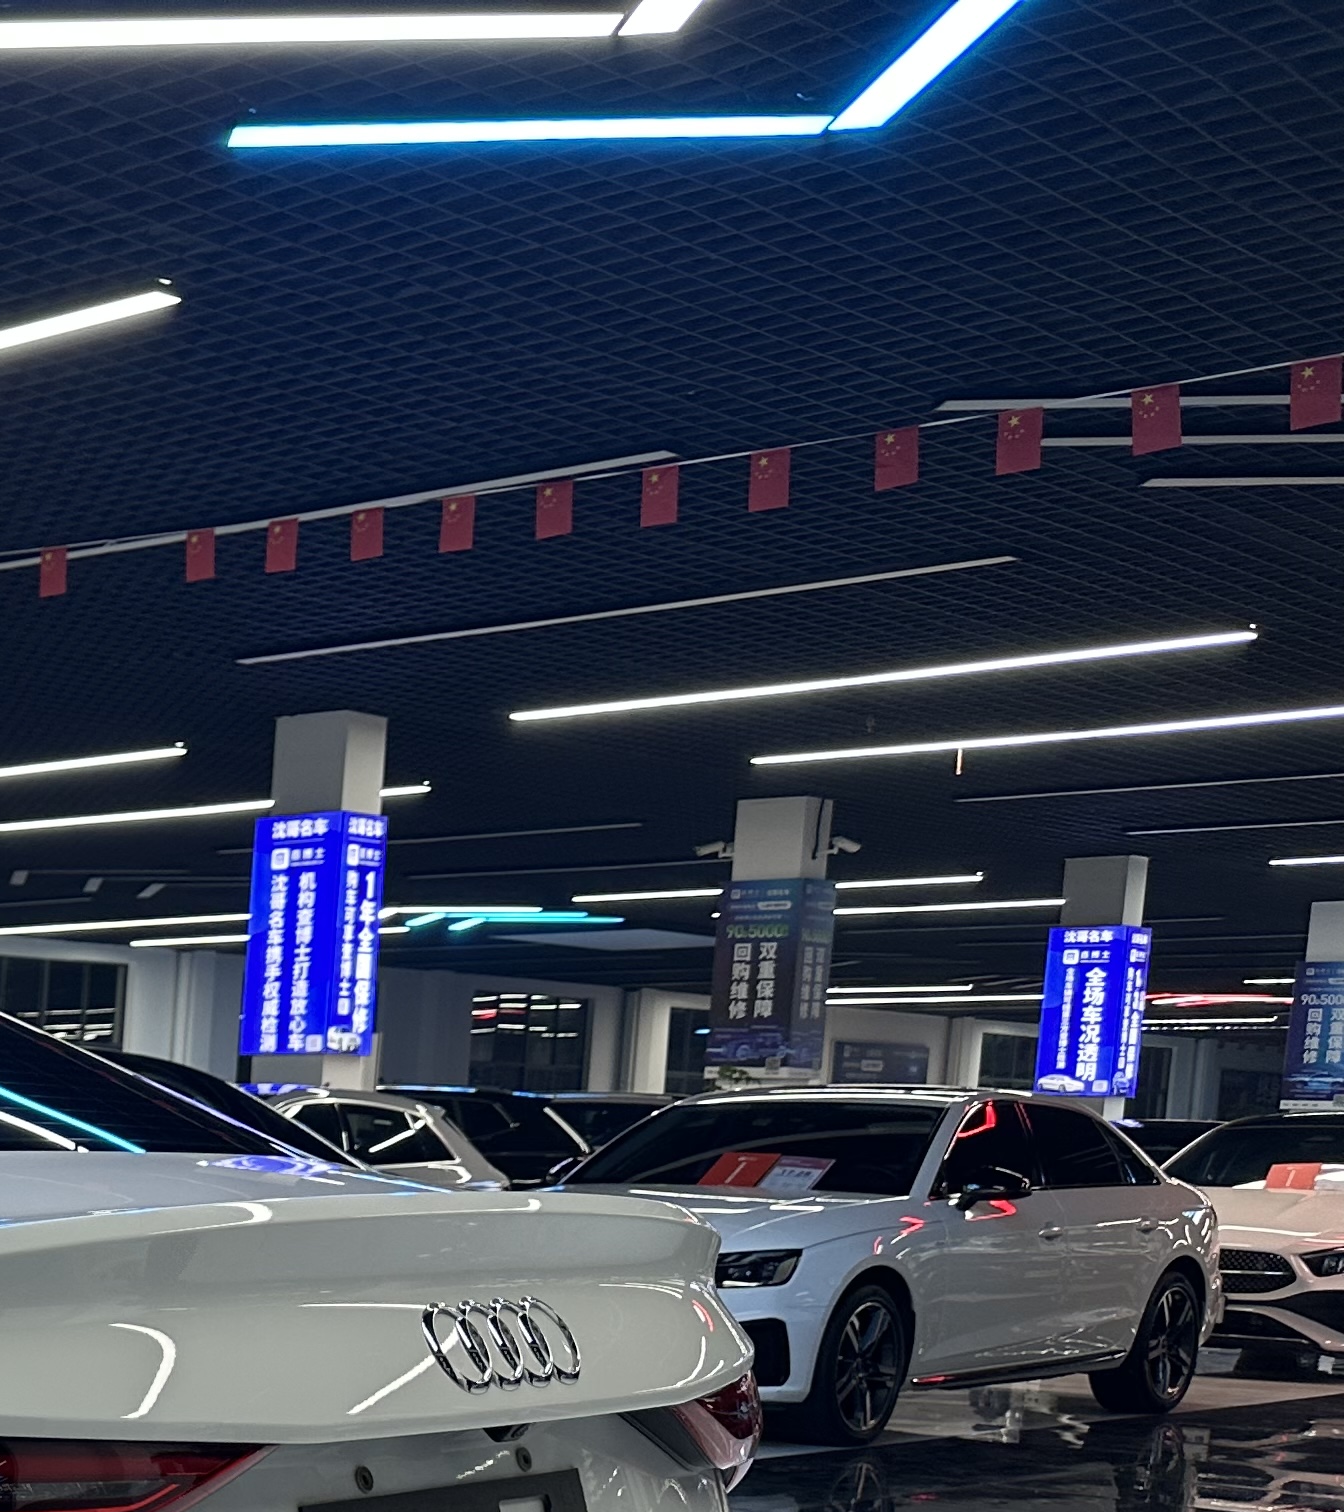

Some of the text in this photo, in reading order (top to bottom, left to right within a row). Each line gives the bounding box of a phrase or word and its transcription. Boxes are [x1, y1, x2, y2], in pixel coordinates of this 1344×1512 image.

[728, 942, 752, 1020] 回购维修
[753, 941, 778, 1019] 双重保障
[1075, 966, 1107, 1082] 全场车况透明
